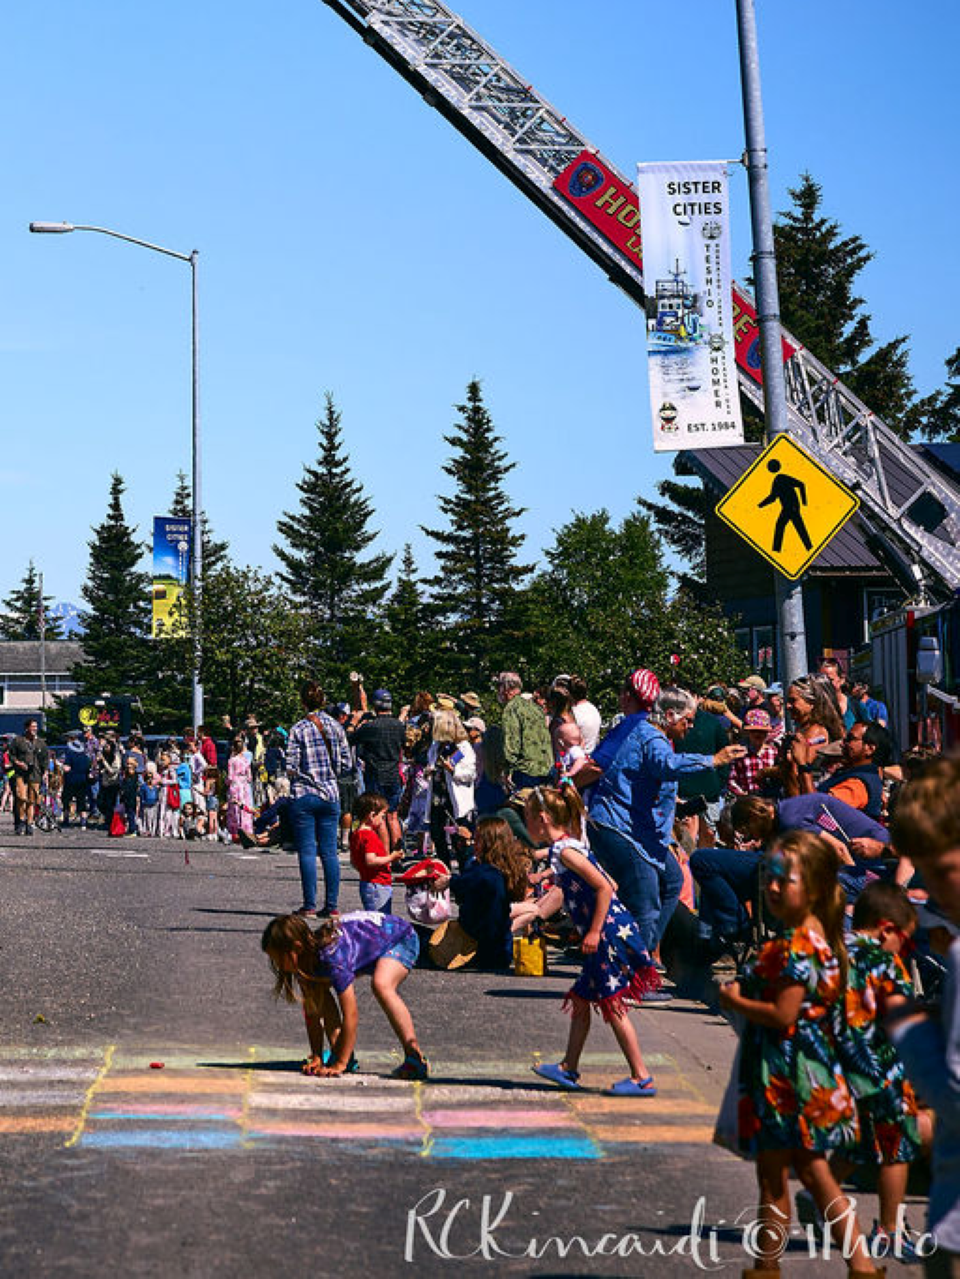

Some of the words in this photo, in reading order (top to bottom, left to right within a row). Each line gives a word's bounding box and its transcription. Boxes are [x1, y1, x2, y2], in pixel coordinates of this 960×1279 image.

[667, 181, 722, 195] SISTER
[594, 186, 642, 236] HO
[672, 202, 722, 216] CITIES
[704, 243, 714, 308] TESHIO
[710, 356, 722, 409] HOMER
[687, 423, 709, 433] EST.
[711, 421, 736, 432] 1984
